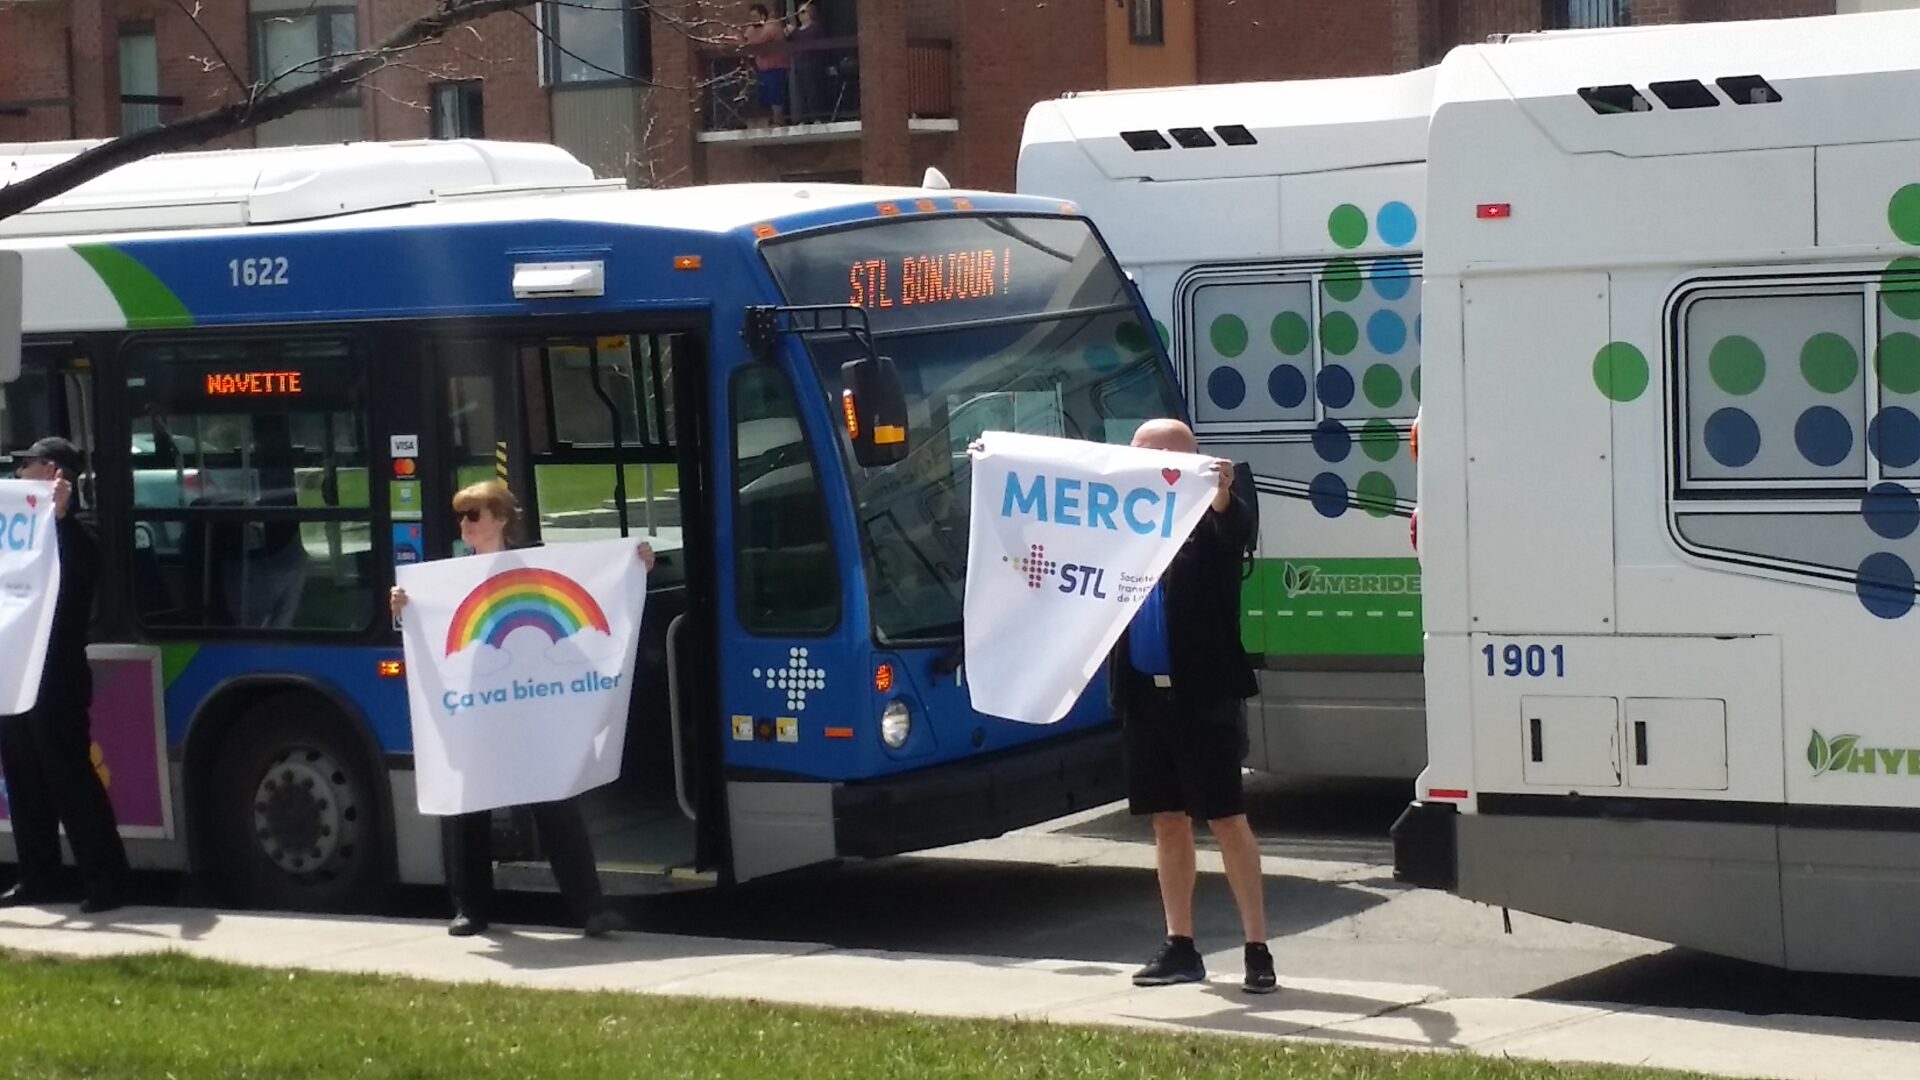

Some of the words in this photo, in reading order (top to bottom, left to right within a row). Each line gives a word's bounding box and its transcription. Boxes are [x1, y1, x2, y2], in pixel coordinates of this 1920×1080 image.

[229, 257, 288, 286] 1622
[850, 258, 893, 308] STL
[901, 249, 996, 304] BONJOUR
[207, 373, 302, 393] NAVETTE
[395, 441, 414, 450] VISA
[1002, 471, 1177, 538] MERCI
[1059, 563, 1106, 599] STL
[1308, 574, 1421, 594] HYBRIDE
[1482, 643, 1563, 677] 1901
[443, 690, 474, 716] Ça
[479, 688, 507, 704] va
[513, 679, 564, 700] bien
[571, 671, 622, 693] aller
